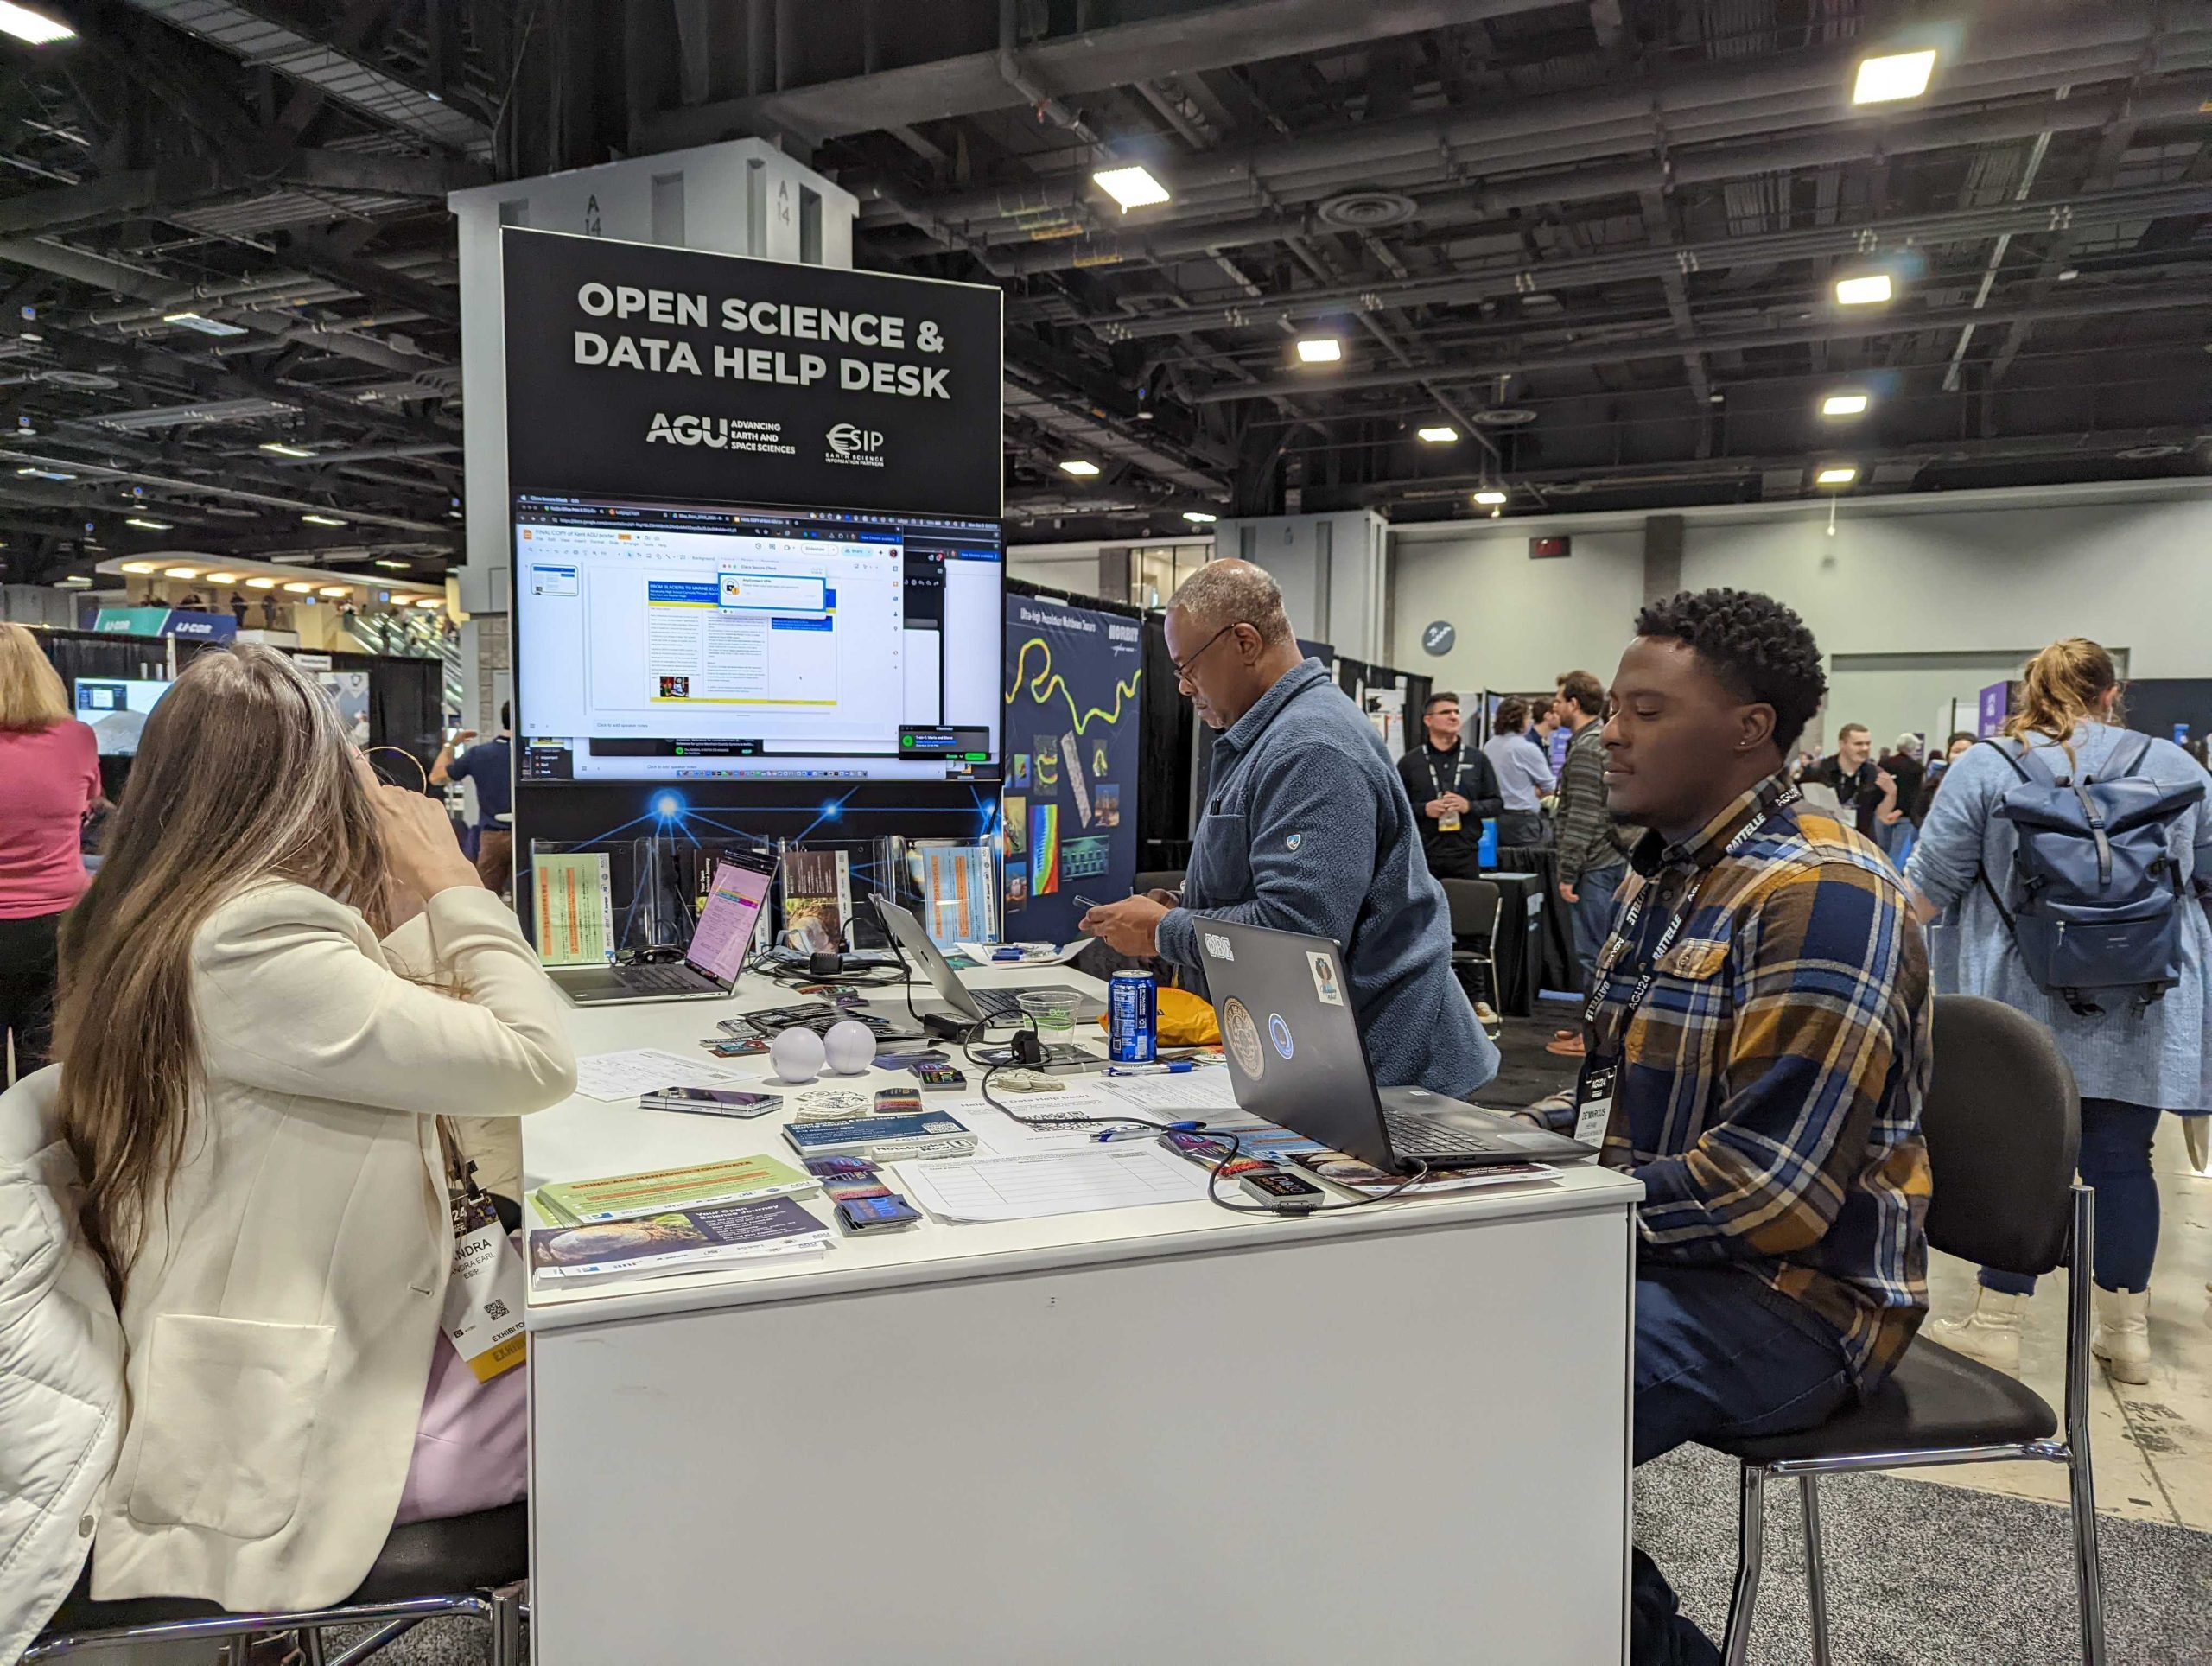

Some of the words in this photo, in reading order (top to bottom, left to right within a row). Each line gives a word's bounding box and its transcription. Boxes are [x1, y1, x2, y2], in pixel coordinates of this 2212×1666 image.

[779, 180, 788, 200] A
[587, 194, 600, 214] A
[777, 201, 790, 226] 14
[585, 219, 601, 237] 14
[577, 282, 708, 328] OPEN
[721, 298, 905, 348] SCIENCE
[916, 321, 944, 353] &
[574, 331, 702, 376] DATA
[714, 345, 826, 385] HELP
[839, 359, 950, 399] DESK
[646, 412, 728, 449] AGU
[731, 420, 781, 431] ADVANCING
[731, 431, 758, 442] EARTH
[760, 433, 779, 442] AND
[825, 423, 884, 455] ESIP
[731, 442, 756, 452] SPACE
[757, 443, 796, 455] SCIENCES
[175, 622, 213, 634] LI-COR
[1725, 812, 1767, 853] BATTELLE
[1626, 889, 1647, 925] TTELLE
[1651, 914, 1682, 961] BATTELLE
[1629, 974, 1651, 1009] AGU24
[875, 1142, 946, 1151] Notebooks
[639, 1168, 691, 1180] MANAGING
[723, 1160, 753, 1169] DATA
[1268, 1176, 1306, 1193] Data
[452, 1206, 467, 1221] 24
[741, 1205, 779, 1214] Journey
[454, 1239, 492, 1261] NDRA
[477, 1252, 496, 1264] EARL
[463, 1269, 480, 1279] ESIP
[492, 1320, 525, 1342] EXHIBITO
